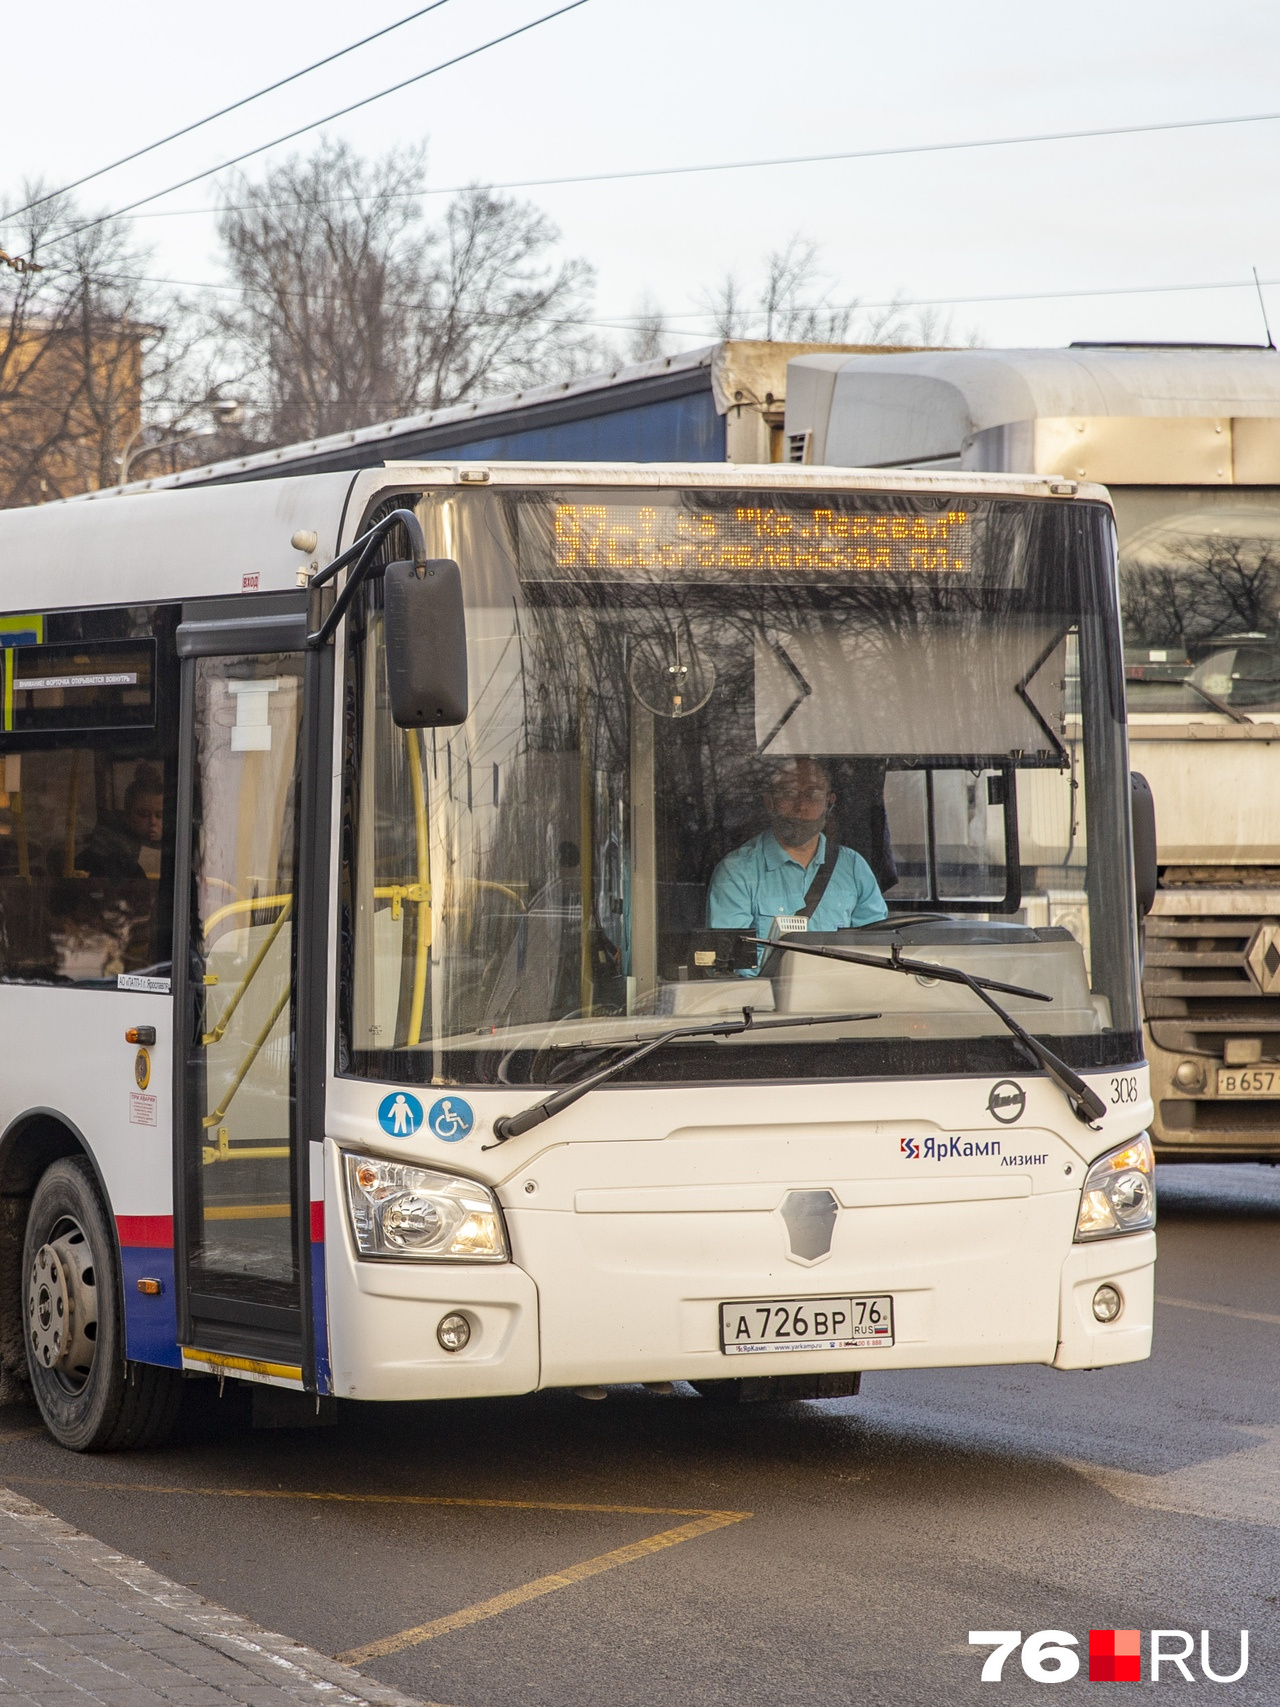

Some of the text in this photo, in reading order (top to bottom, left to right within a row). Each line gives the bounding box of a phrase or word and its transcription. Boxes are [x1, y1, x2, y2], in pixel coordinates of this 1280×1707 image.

[1110, 1076, 1138, 1104] 308
[923, 1136, 1001, 1161] ЯрКамп
[855, 1302, 881, 1325] 76
[854, 1325, 874, 1335] RUS
